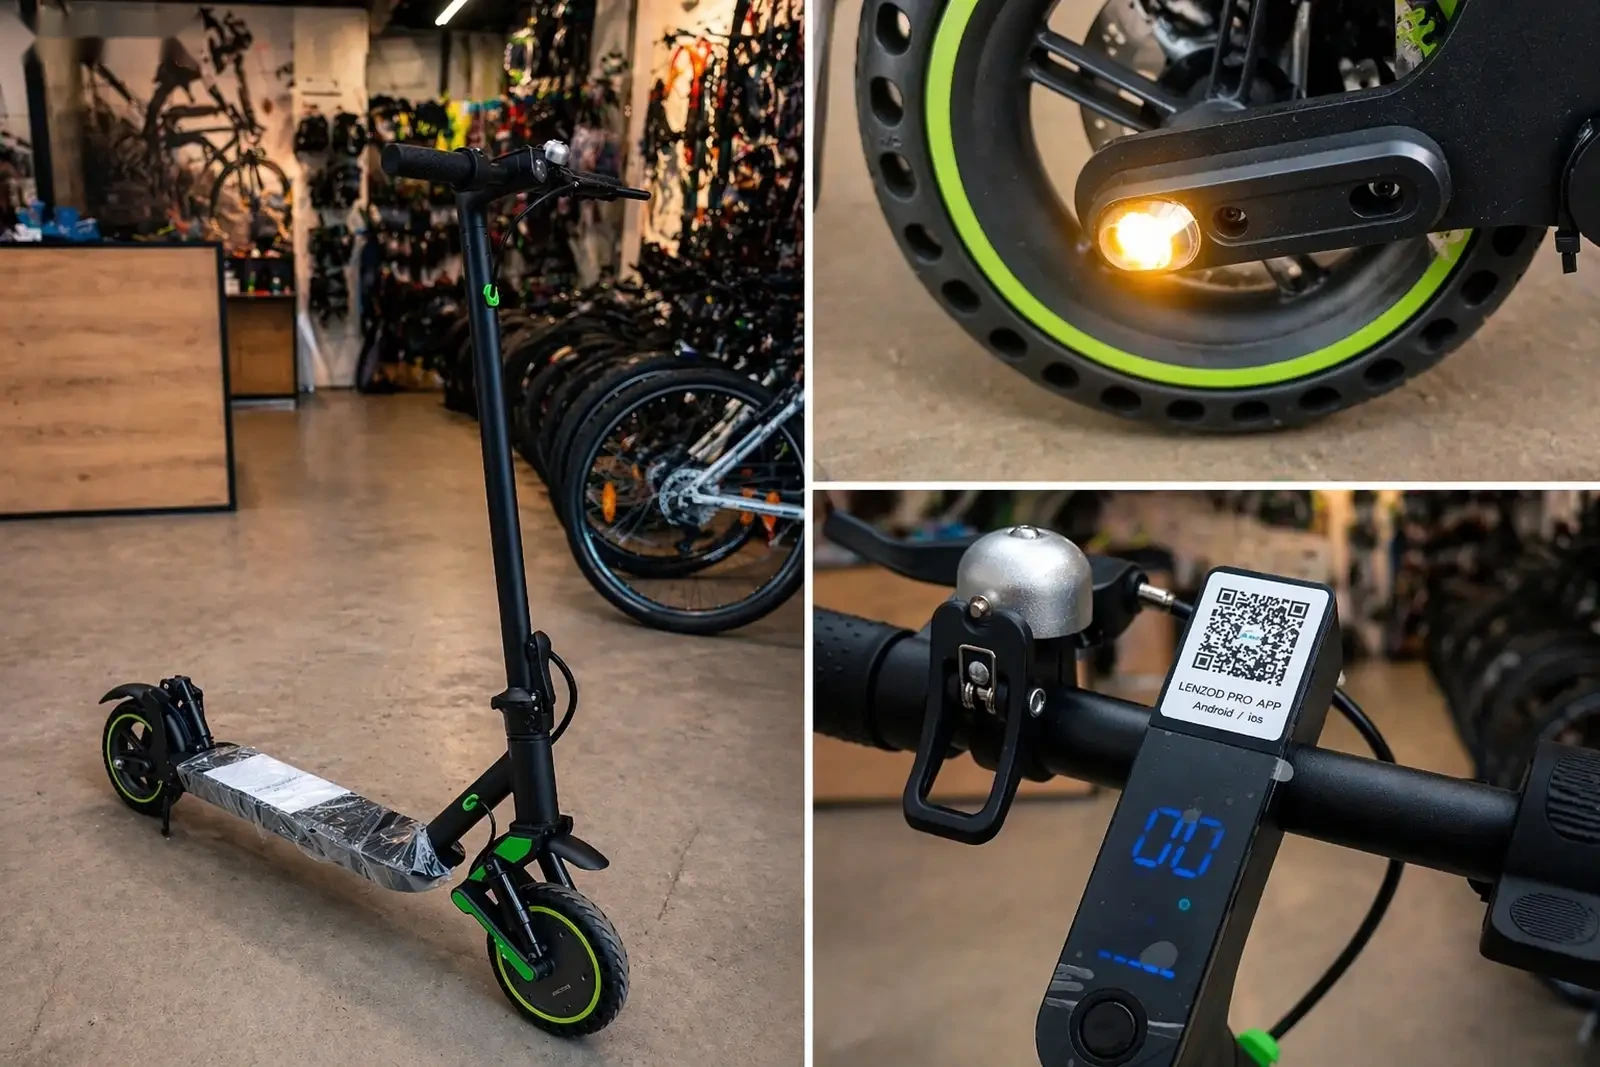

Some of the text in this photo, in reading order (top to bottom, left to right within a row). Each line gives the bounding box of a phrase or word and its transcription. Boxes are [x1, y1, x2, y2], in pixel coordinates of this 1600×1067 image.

[1178, 681, 1282, 710] LENZOD PRO APP
[1192, 701, 1235, 718] Android
[1131, 806, 1226, 879] 00
